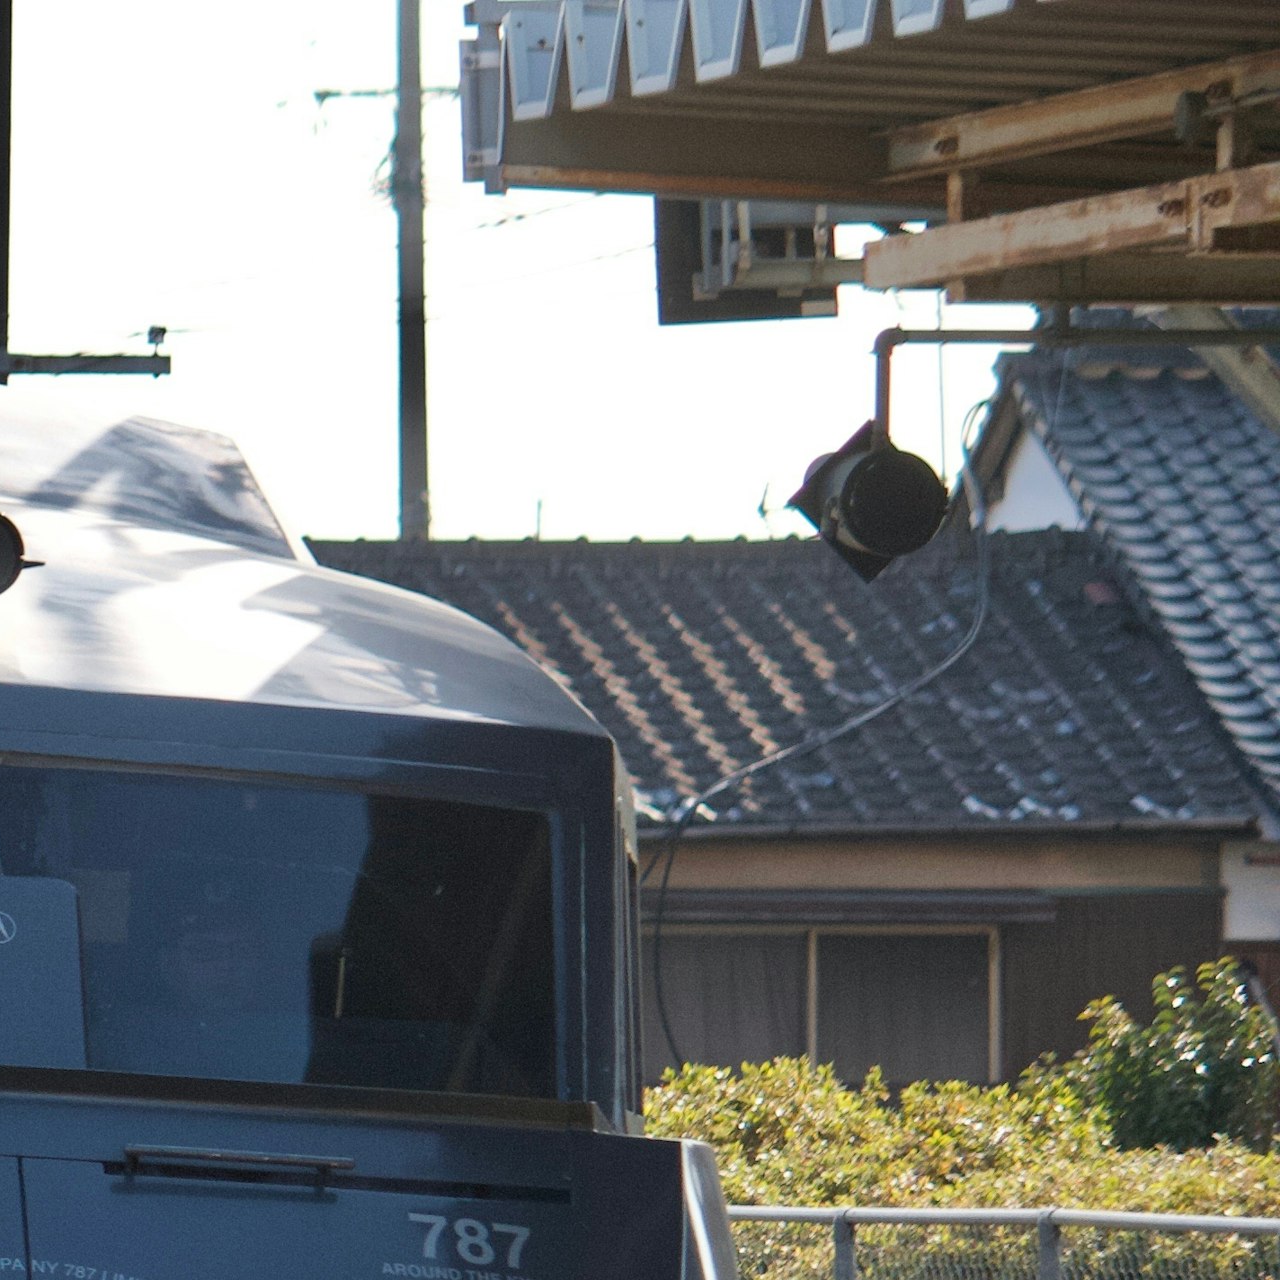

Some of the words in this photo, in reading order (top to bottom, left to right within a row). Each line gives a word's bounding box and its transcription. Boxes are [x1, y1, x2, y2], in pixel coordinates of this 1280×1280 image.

[408, 1212, 531, 1269] 787
[64, 1263, 96, 1279] 787
[382, 1262, 462, 1280] AROUND
